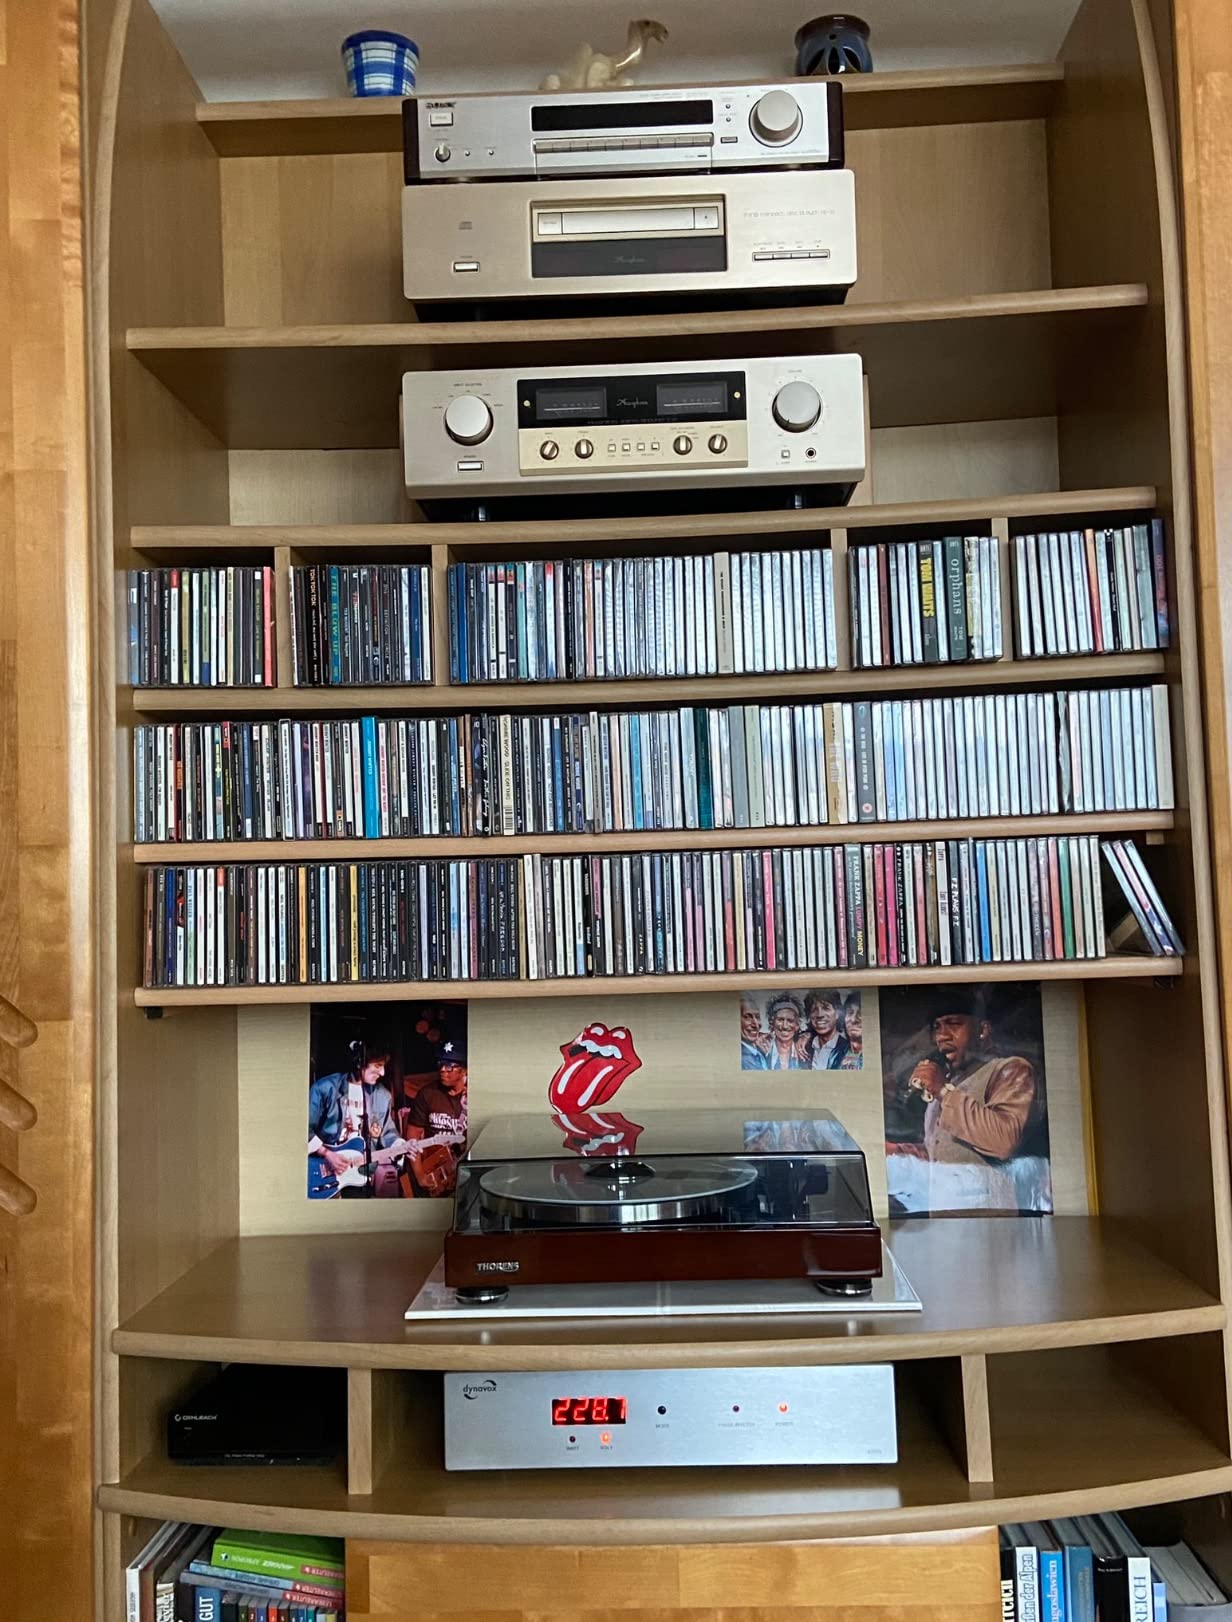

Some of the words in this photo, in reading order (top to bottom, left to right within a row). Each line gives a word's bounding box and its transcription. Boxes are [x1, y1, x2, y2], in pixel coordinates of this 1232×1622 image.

[920, 558, 932, 581] TOM
[949, 558, 963, 615] orphans
[922, 583, 934, 618] WAITS
[852, 856, 860, 880] FRANK
[854, 882, 862, 905] ZAPPA
[856, 931, 864, 956] MONEY
[477, 1262, 520, 1272] THORENS
[463, 1383, 497, 1395] dynavox
[1018, 1554, 1038, 1581] Alpen
[1020, 1582, 1034, 1600] der
[1134, 1576, 1148, 1622] REICH
[199, 1596, 214, 1621] GUT
